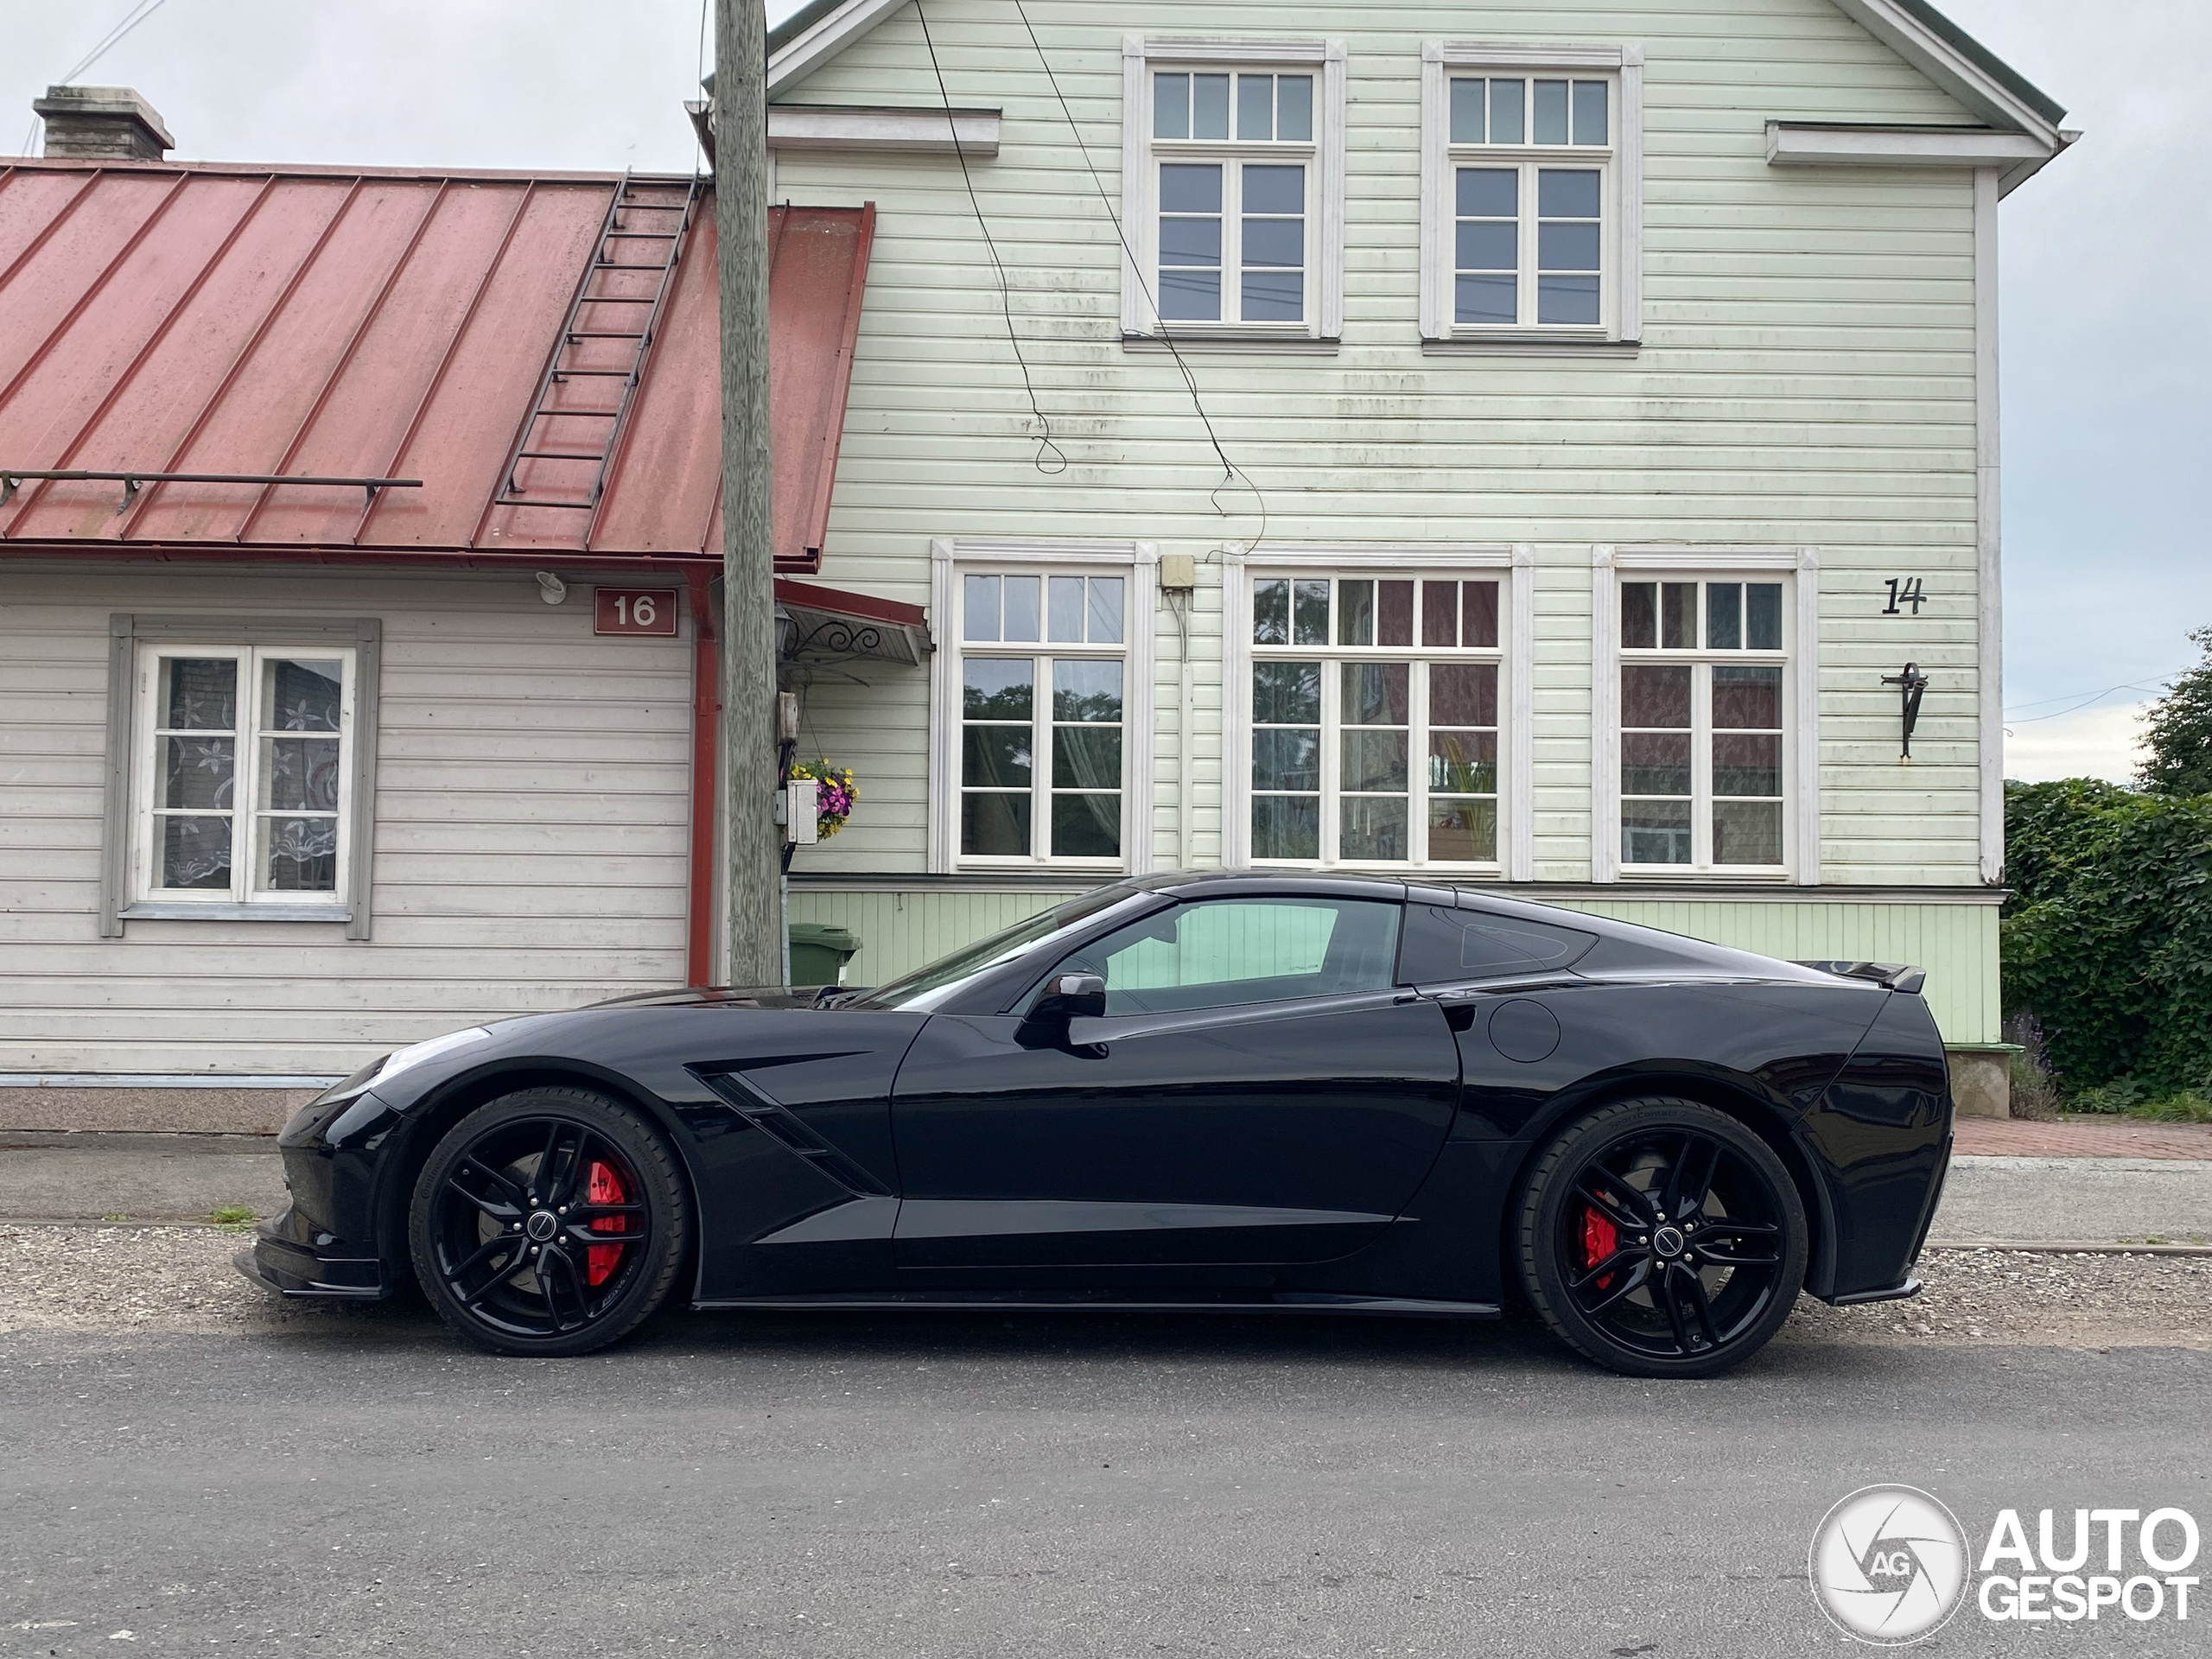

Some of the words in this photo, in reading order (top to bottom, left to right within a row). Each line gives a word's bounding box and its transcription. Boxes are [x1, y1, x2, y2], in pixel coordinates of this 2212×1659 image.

[614, 595, 656, 626] 16
[1882, 577, 1927, 614] 14
[1608, 1109, 1678, 1128] SportContact
[421, 1144, 454, 1199] Continental
